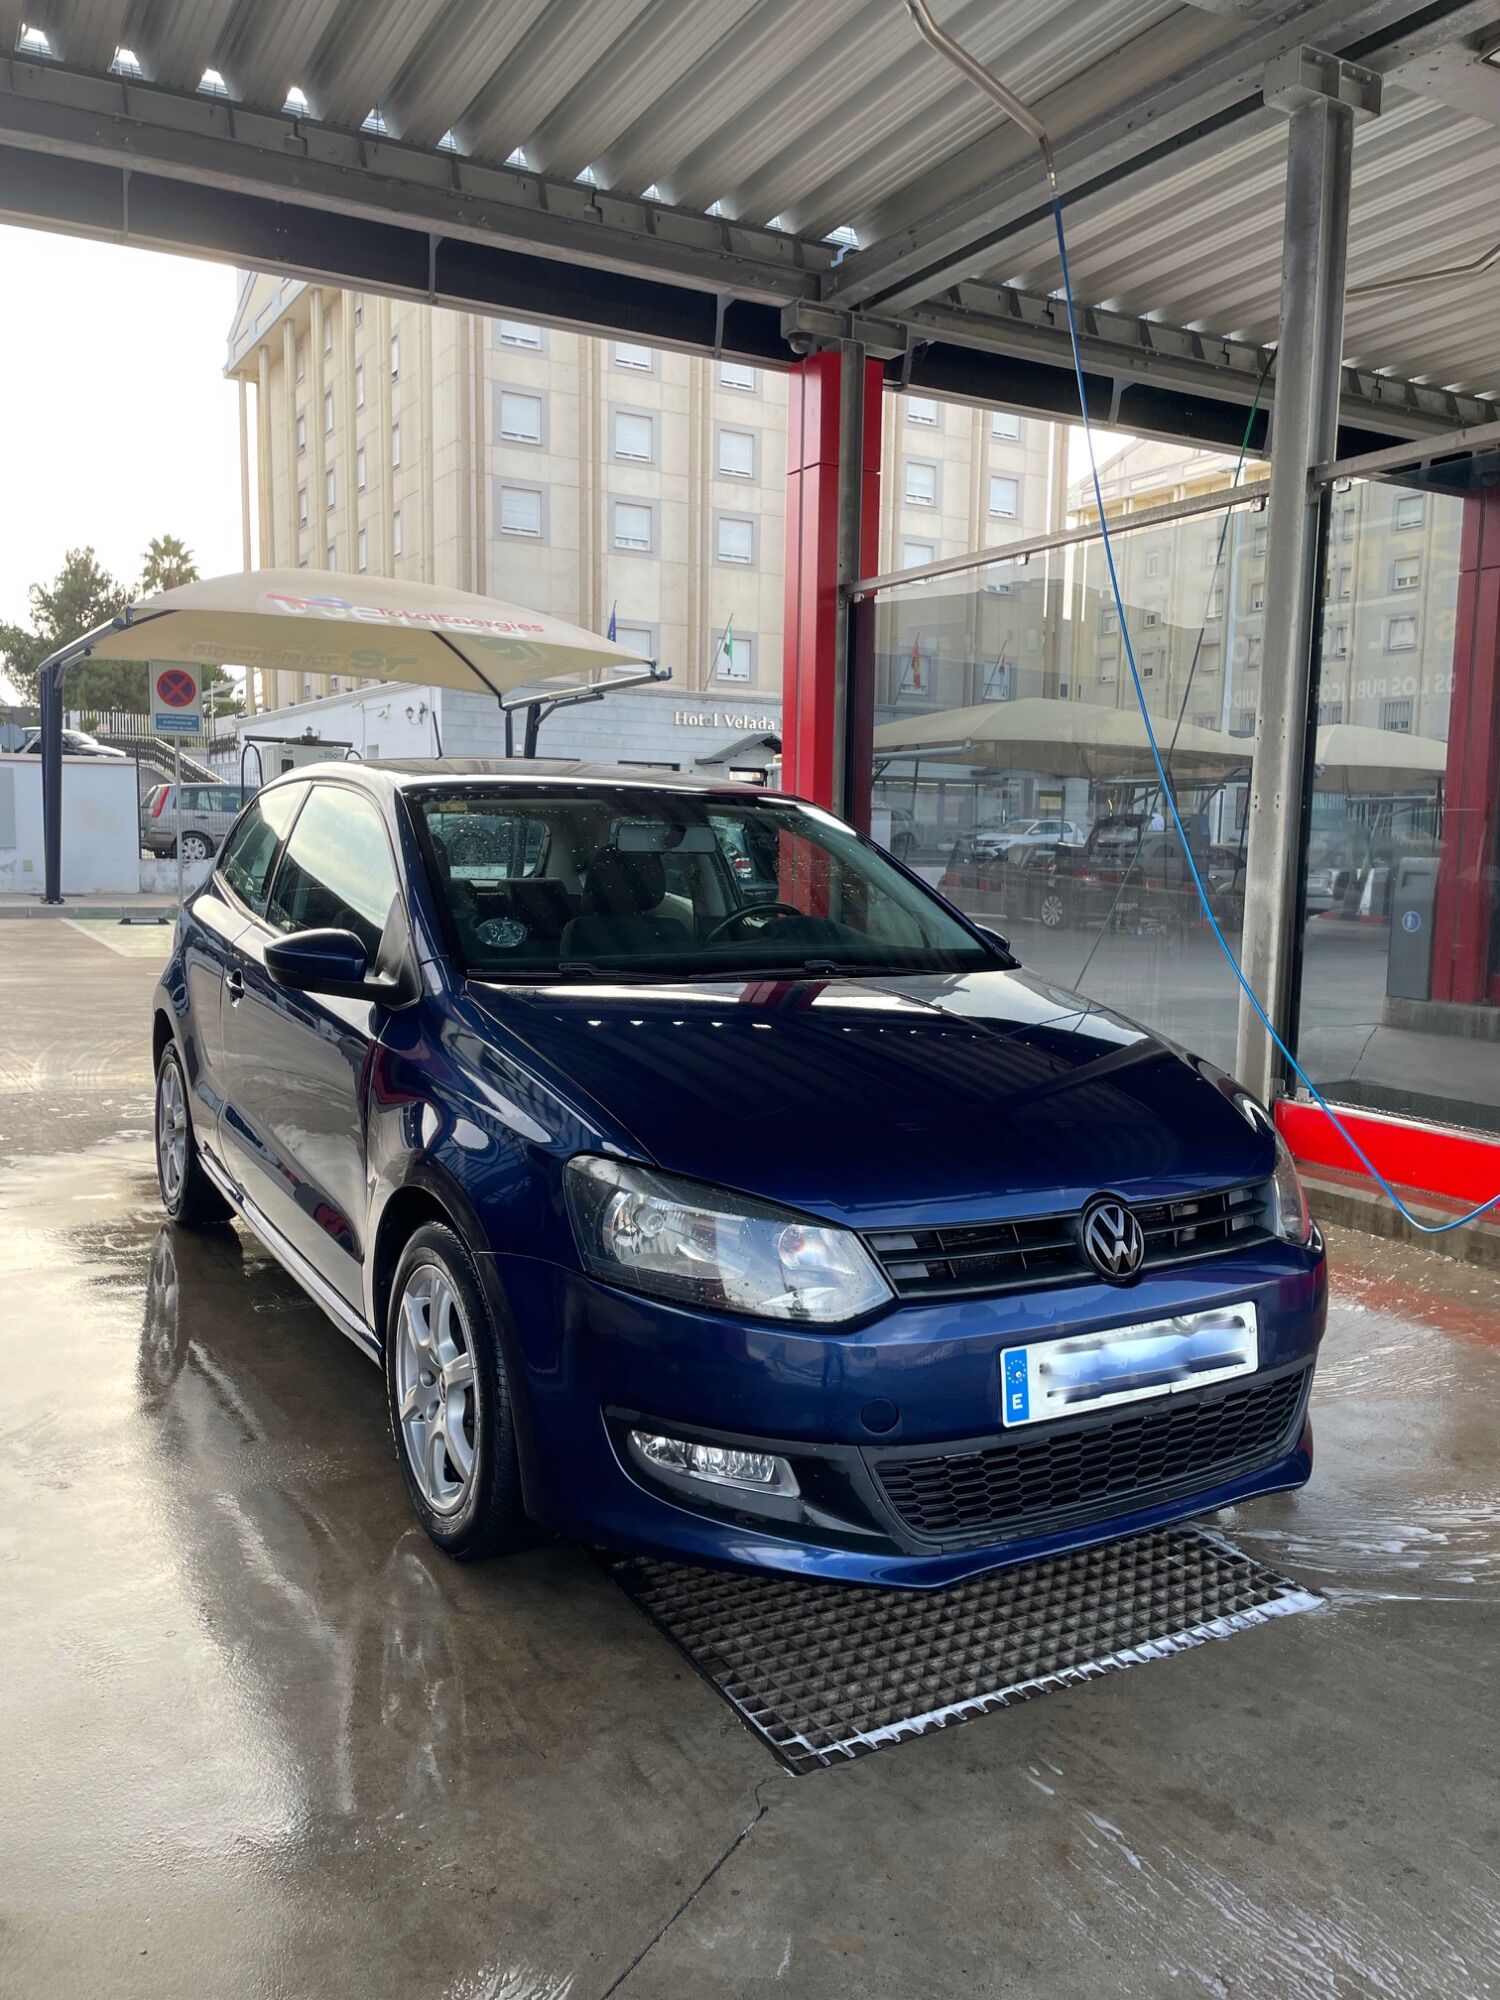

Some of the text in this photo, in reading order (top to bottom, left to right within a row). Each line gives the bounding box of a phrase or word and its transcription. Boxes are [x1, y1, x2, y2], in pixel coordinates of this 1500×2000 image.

[377, 606, 545, 633] TotalEnergies
[674, 711, 775, 730] Hotel Velada
[1011, 1393, 1023, 1410] E
